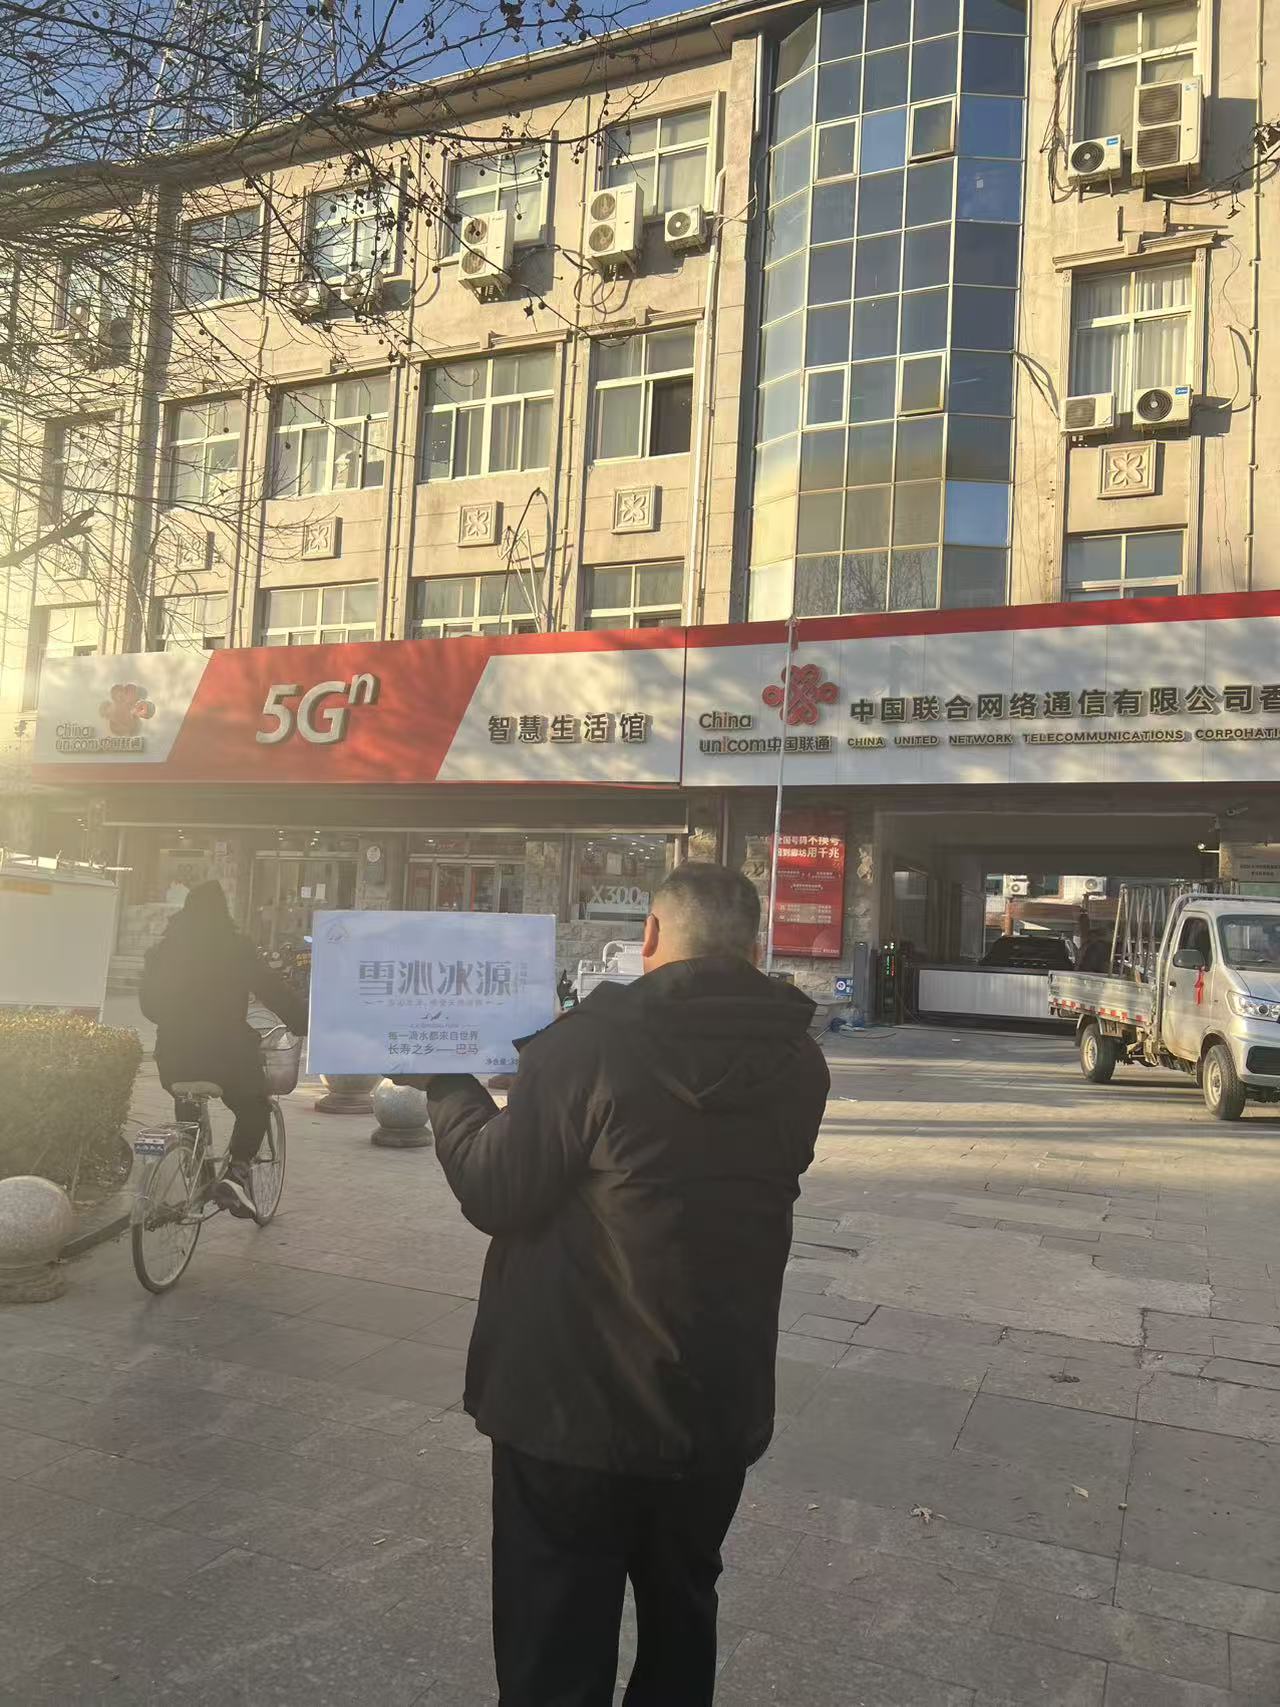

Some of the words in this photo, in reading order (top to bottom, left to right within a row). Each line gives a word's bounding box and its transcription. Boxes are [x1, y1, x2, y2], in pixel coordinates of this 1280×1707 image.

[488, 712, 648, 743] 智慧生活馆
[699, 712, 752, 729] China
[56, 723, 91, 738] China
[847, 737, 884, 747] CHINA
[894, 735, 939, 746] UNITED
[950, 733, 1013, 745] NETWORK
[1023, 730, 1184, 744] TELECOMMUNICATIONS
[359, 960, 511, 996] 雪沁冰源
